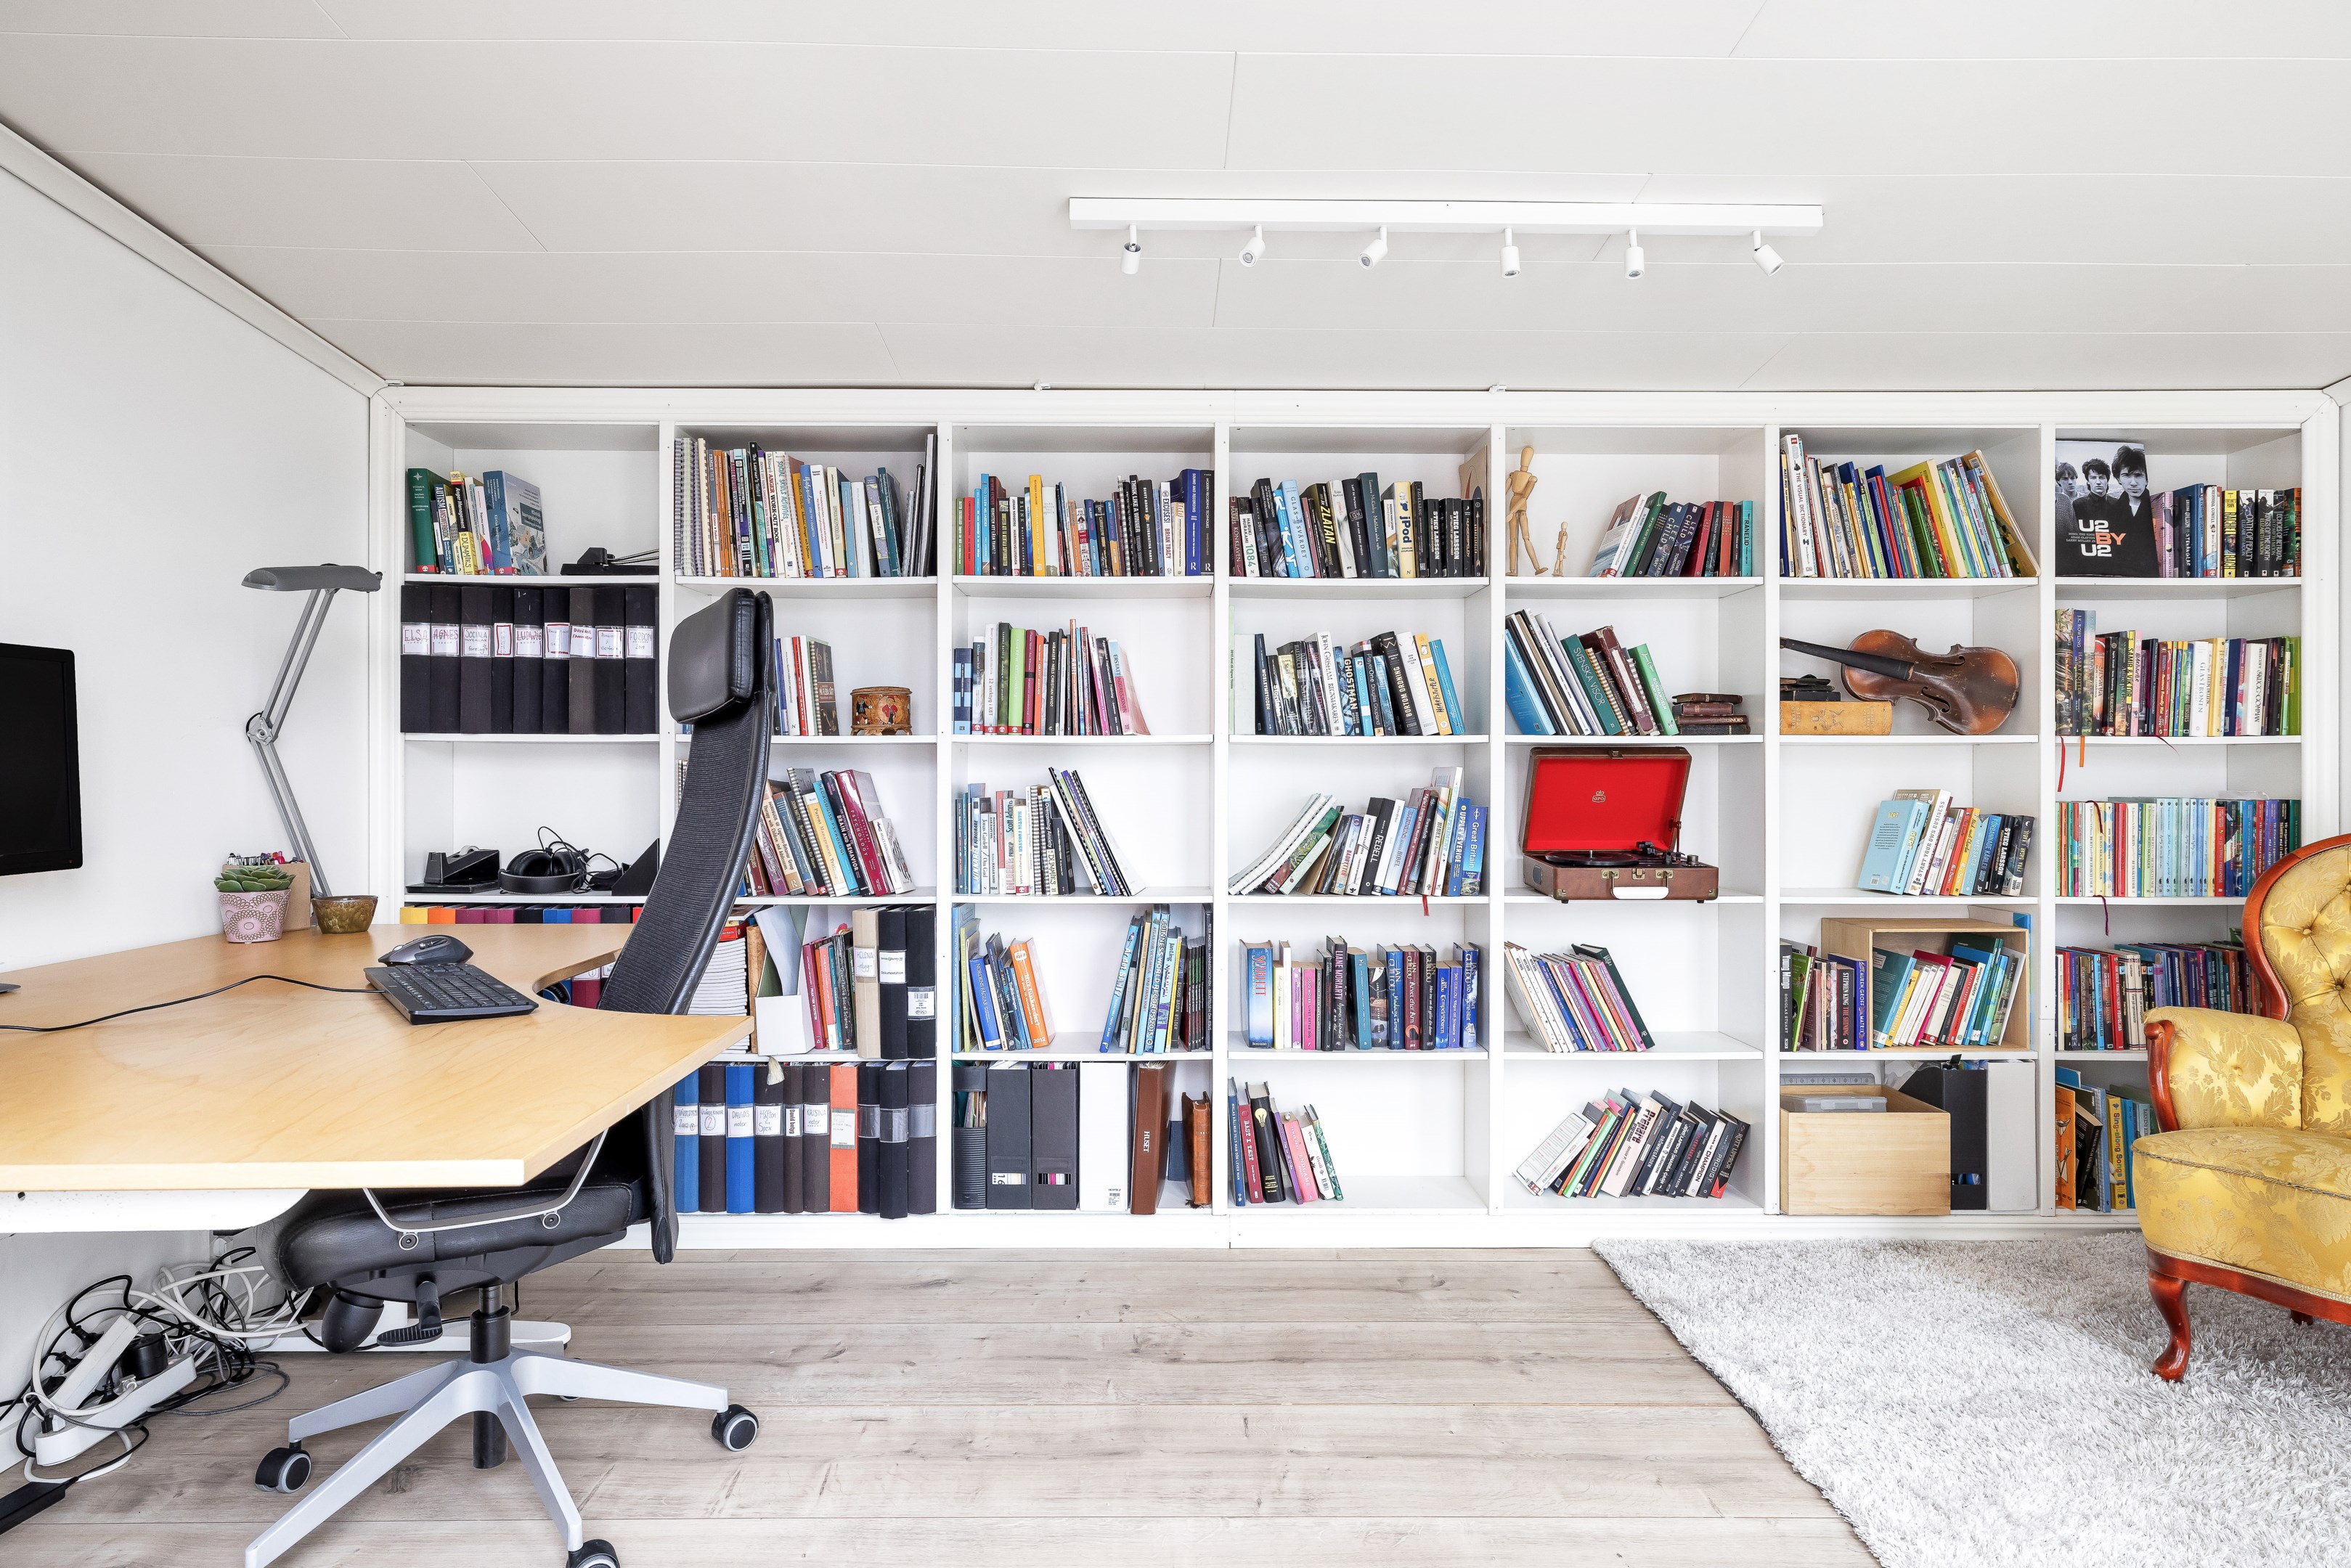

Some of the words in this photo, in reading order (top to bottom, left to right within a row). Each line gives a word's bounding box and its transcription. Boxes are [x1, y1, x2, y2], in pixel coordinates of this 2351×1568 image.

[436, 486, 446, 508] AUTISM
[780, 497, 789, 519] ACTIVITIES
[439, 510, 449, 539] ANSWERBOOK
[1320, 506, 1336, 544] ZLATAN
[1400, 516, 1412, 543] jPod
[1661, 518, 1675, 544] CHILD
[1668, 525, 1679, 541] LEE
[1680, 515, 1692, 538] CHILD
[1687, 522, 1696, 536] LEE
[2078, 519, 2109, 532] U2
[2245, 531, 2253, 540] OF
[1297, 526, 1307, 558] SVÄRDET
[2095, 532, 2126, 545] BY
[461, 537, 470, 568] DUMMIES
[1245, 544, 1256, 567] 1Q84
[2081, 544, 2112, 557] U2
[2224, 553, 2236, 569] BACH
[405, 629, 428, 642] ELSA
[433, 629, 459, 640] AGNES
[517, 630, 542, 640] LUDWIG
[630, 632, 651, 641] FORDON
[1324, 651, 1332, 680] GRISHAM
[1328, 683, 1339, 724] REGNMAKAREN
[1344, 659, 1358, 709] GHOSTMAN
[1393, 666, 1405, 693] ORDNING
[1573, 647, 1594, 681] SVENSKA
[1589, 682, 1605, 706] VISOR
[1117, 677, 1127, 713] AGGRESJONEN
[1400, 693, 1413, 717] BORTOM
[817, 783, 833, 821] PEDAGOGISK
[831, 822, 844, 855] PSYKOLOGI
[1005, 801, 1014, 818] Adams
[1931, 801, 1946, 827] BUSINESS
[1470, 822, 1479, 842] Great
[1907, 830, 1917, 850] BERT
[1928, 828, 1936, 842] OWN
[2002, 828, 2010, 846] STIEG
[846, 844, 858, 871] BEHAVIOR
[1369, 834, 1385, 863] REBELL
[1454, 837, 1464, 863] SVERIGE
[1469, 844, 1478, 868] Britain
[1924, 842, 1933, 856] YOUR
[1918, 858, 1929, 877] START
[1997, 847, 2008, 875] LARSSON
[1157, 919, 1168, 955] GUINNESS
[1781, 955, 1790, 971] Young
[1115, 973, 1126, 997] SANT?
[1252, 955, 1266, 996] SCARLETT
[1781, 972, 1791, 989] Mungo
[1027, 988, 1037, 1011] funkar
[1150, 985, 1160, 1018] RECORDS
[1031, 1012, 1040, 1026] det?
[707, 1116, 713, 1128] 2
[732, 1111, 750, 1119] DAVIDS
[1631, 1108, 1656, 1144] Prepare
[2113, 1113, 2122, 1152] Sing-along
[1695, 1151, 1712, 1183] CHAMPION
[1706, 1153, 1723, 1183] PRODIGY
